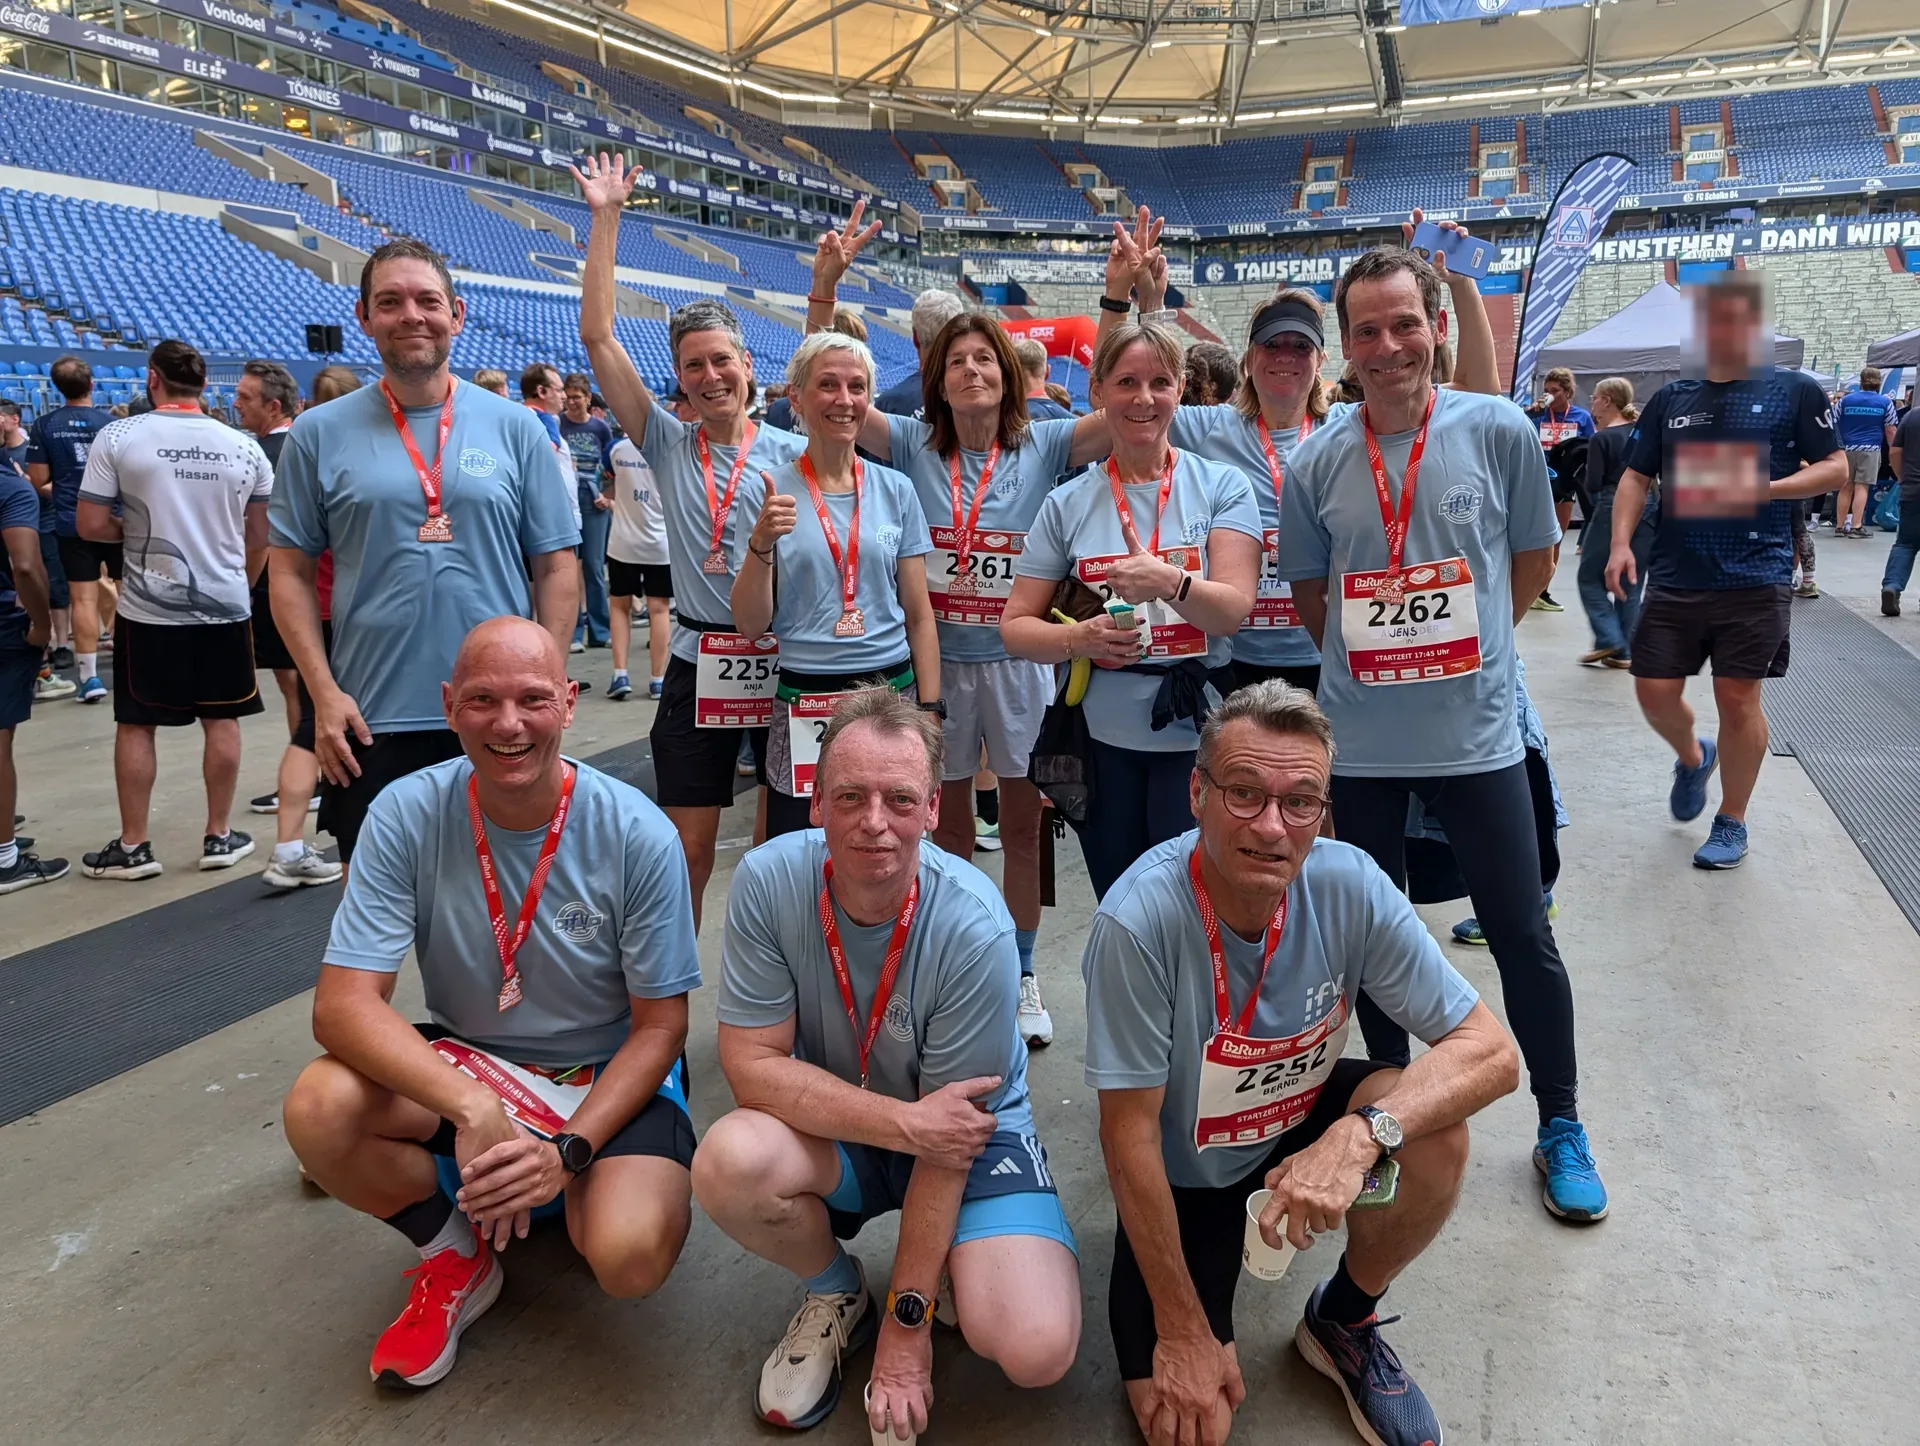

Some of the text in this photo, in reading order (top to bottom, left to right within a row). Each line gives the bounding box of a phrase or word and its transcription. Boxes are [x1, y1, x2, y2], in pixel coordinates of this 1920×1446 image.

[204, 2, 267, 33] Vontobel
[97, 33, 160, 58] SCHEFFER
[183, 58, 208, 77] ELE
[1697, 151, 1723, 159] VELTINS
[1228, 223, 1267, 235] VELTINS
[1561, 234, 1584, 243] ALDI
[1234, 257, 1335, 281] TAUSEND
[1760, 225, 1838, 251] DANN
[1696, 249, 1726, 258] VELTINS
[156, 445, 228, 463] agathon
[174, 468, 219, 481] Hasan
[633, 489, 649, 503] 840
[936, 530, 957, 542] B2Ru
[946, 552, 1013, 580] 2261
[948, 598, 979, 607] STARTZEIT
[1368, 592, 1451, 627] 2262
[1389, 626, 1418, 638] JENS
[1374, 648, 1450, 662] STARTZEIT 17:45 Uhr
[718, 658, 780, 681] 2254
[743, 683, 763, 691] ANJA
[1221, 1039, 1266, 1057] B2Run
[1234, 1040, 1328, 1094] 2252
[468, 1052, 536, 1110] STARTZEIT 17:45 Uhr
[1262, 1077, 1299, 1096] BERND
[1236, 1092, 1316, 1124] STARTZEIT 17:45 Uhr
